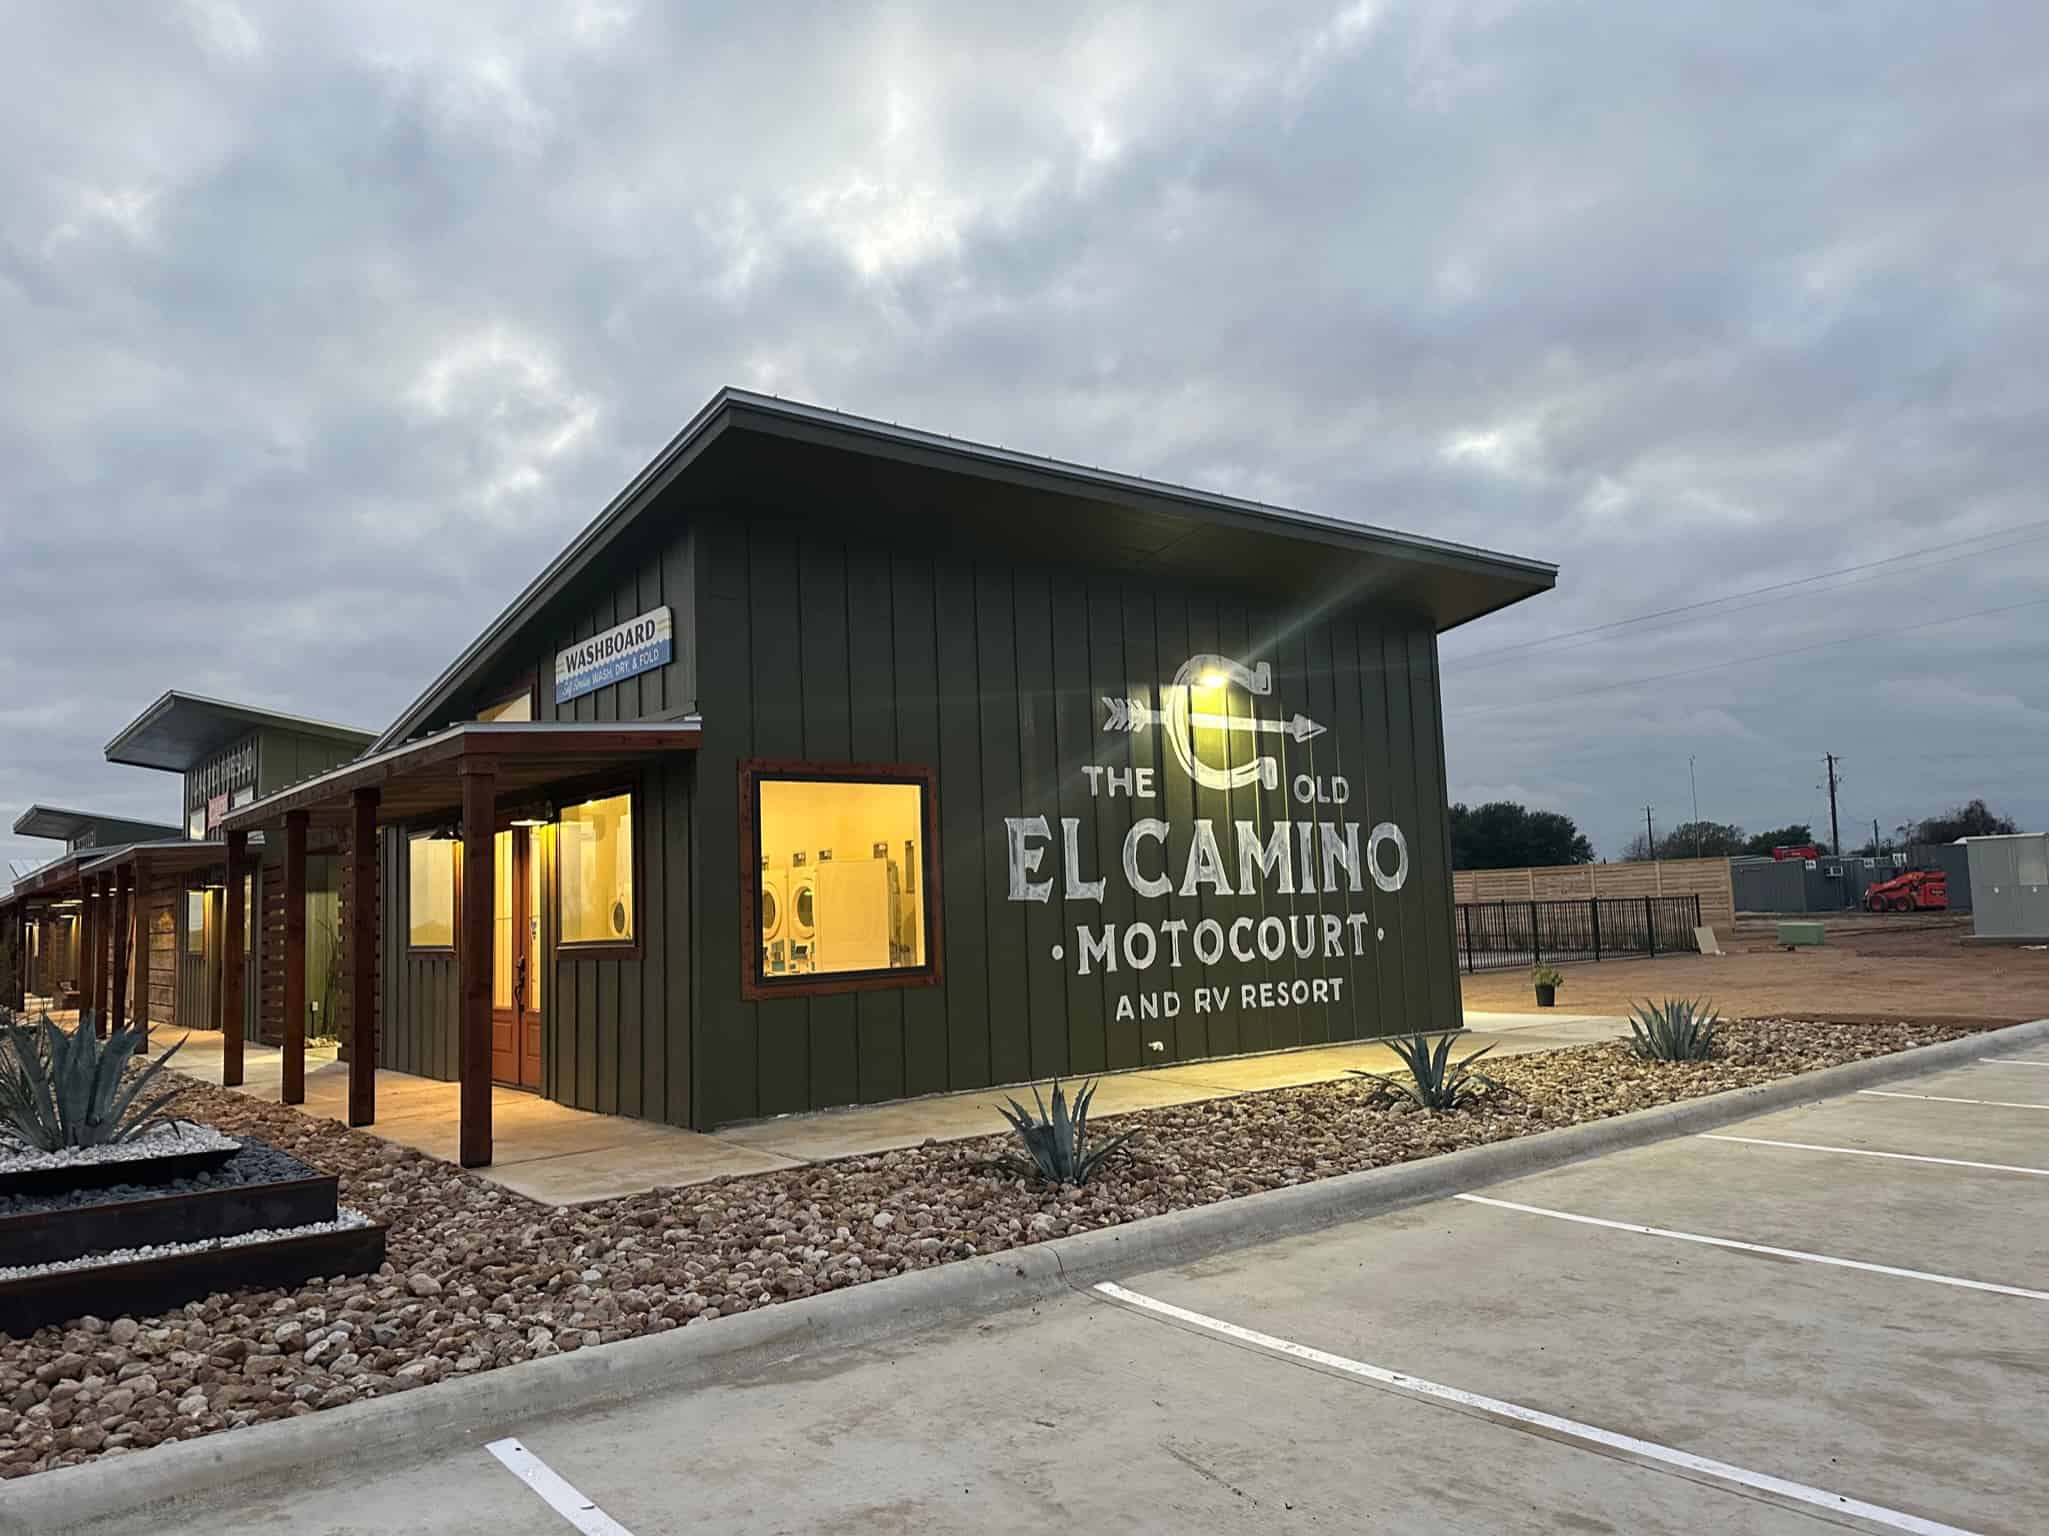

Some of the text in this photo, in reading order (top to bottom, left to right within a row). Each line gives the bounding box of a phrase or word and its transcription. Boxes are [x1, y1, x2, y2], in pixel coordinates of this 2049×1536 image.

[565, 619, 656, 673] WASHBOARD
[1081, 765, 1350, 805] THE OLD
[1004, 814, 1410, 904] EL CAMINO
[1075, 911, 1369, 975] MOTOCOURT
[1115, 977, 1344, 1022] AND RV RESORT
